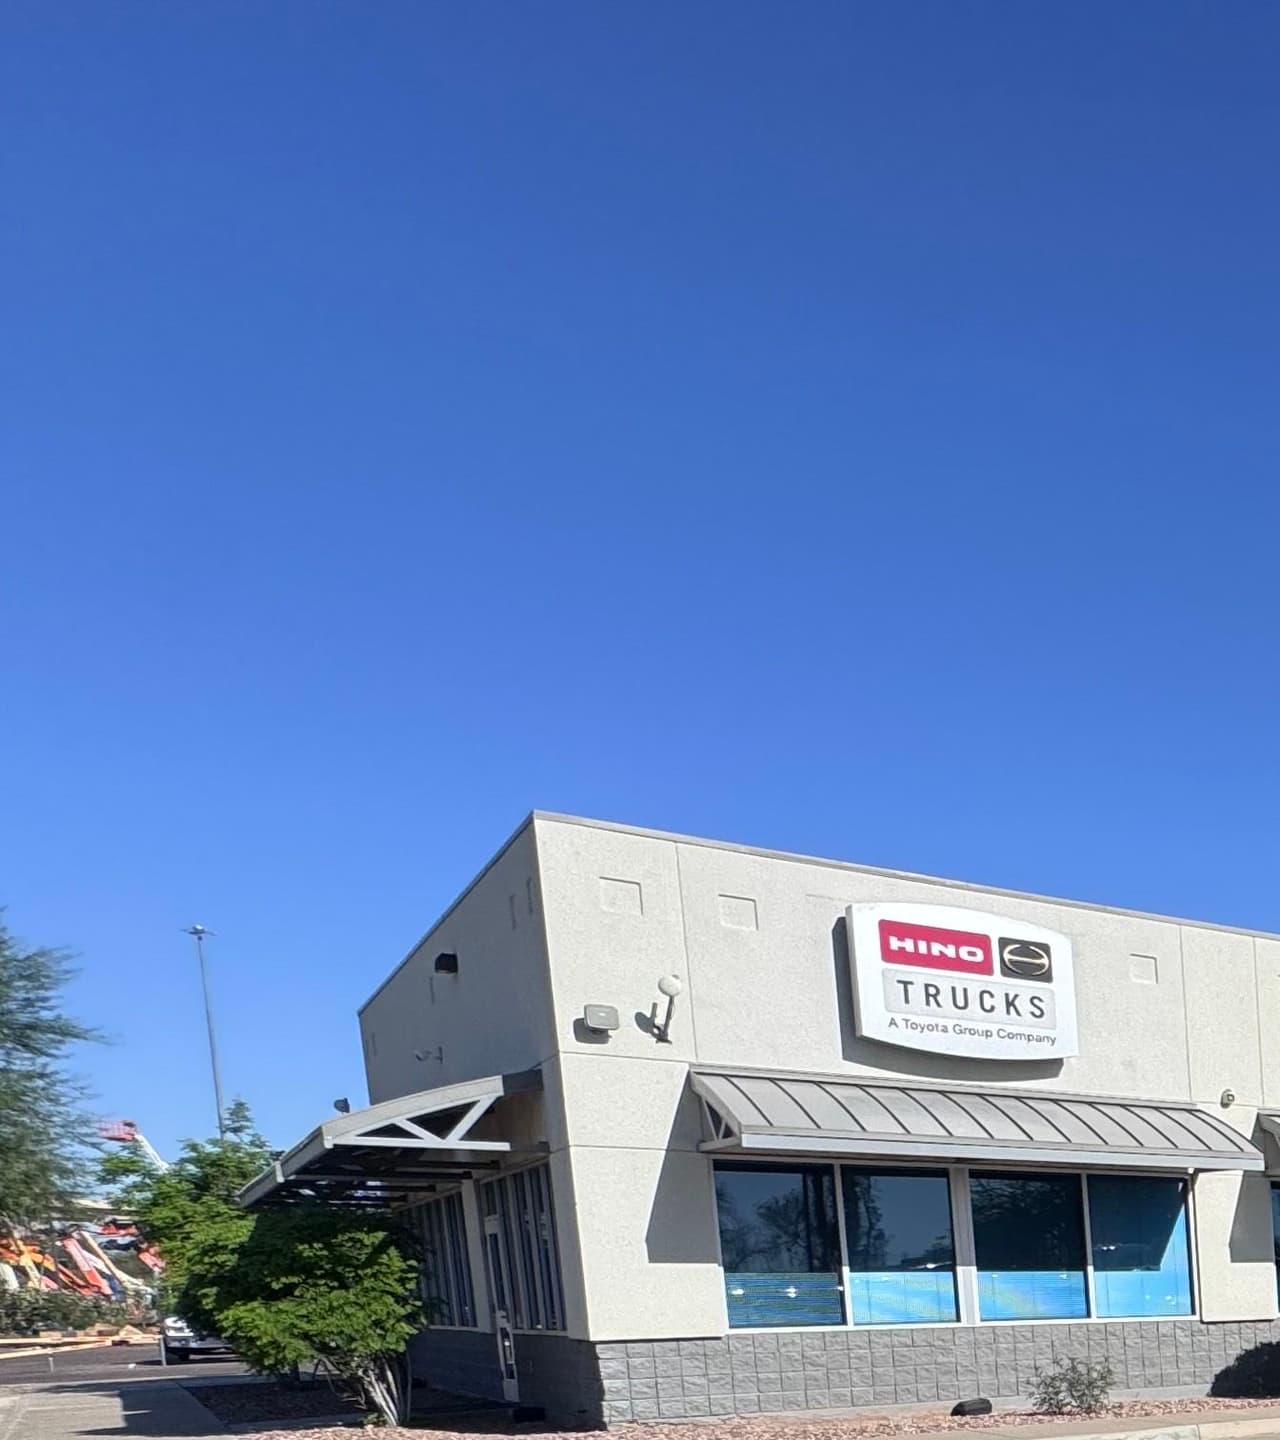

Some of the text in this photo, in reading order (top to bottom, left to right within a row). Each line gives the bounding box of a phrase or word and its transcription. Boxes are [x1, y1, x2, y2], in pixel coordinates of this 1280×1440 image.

[889, 936, 985, 963] HINO
[896, 979, 1046, 1019] TRUCKS
[888, 1017, 1057, 1047] A Toyota Group Company
